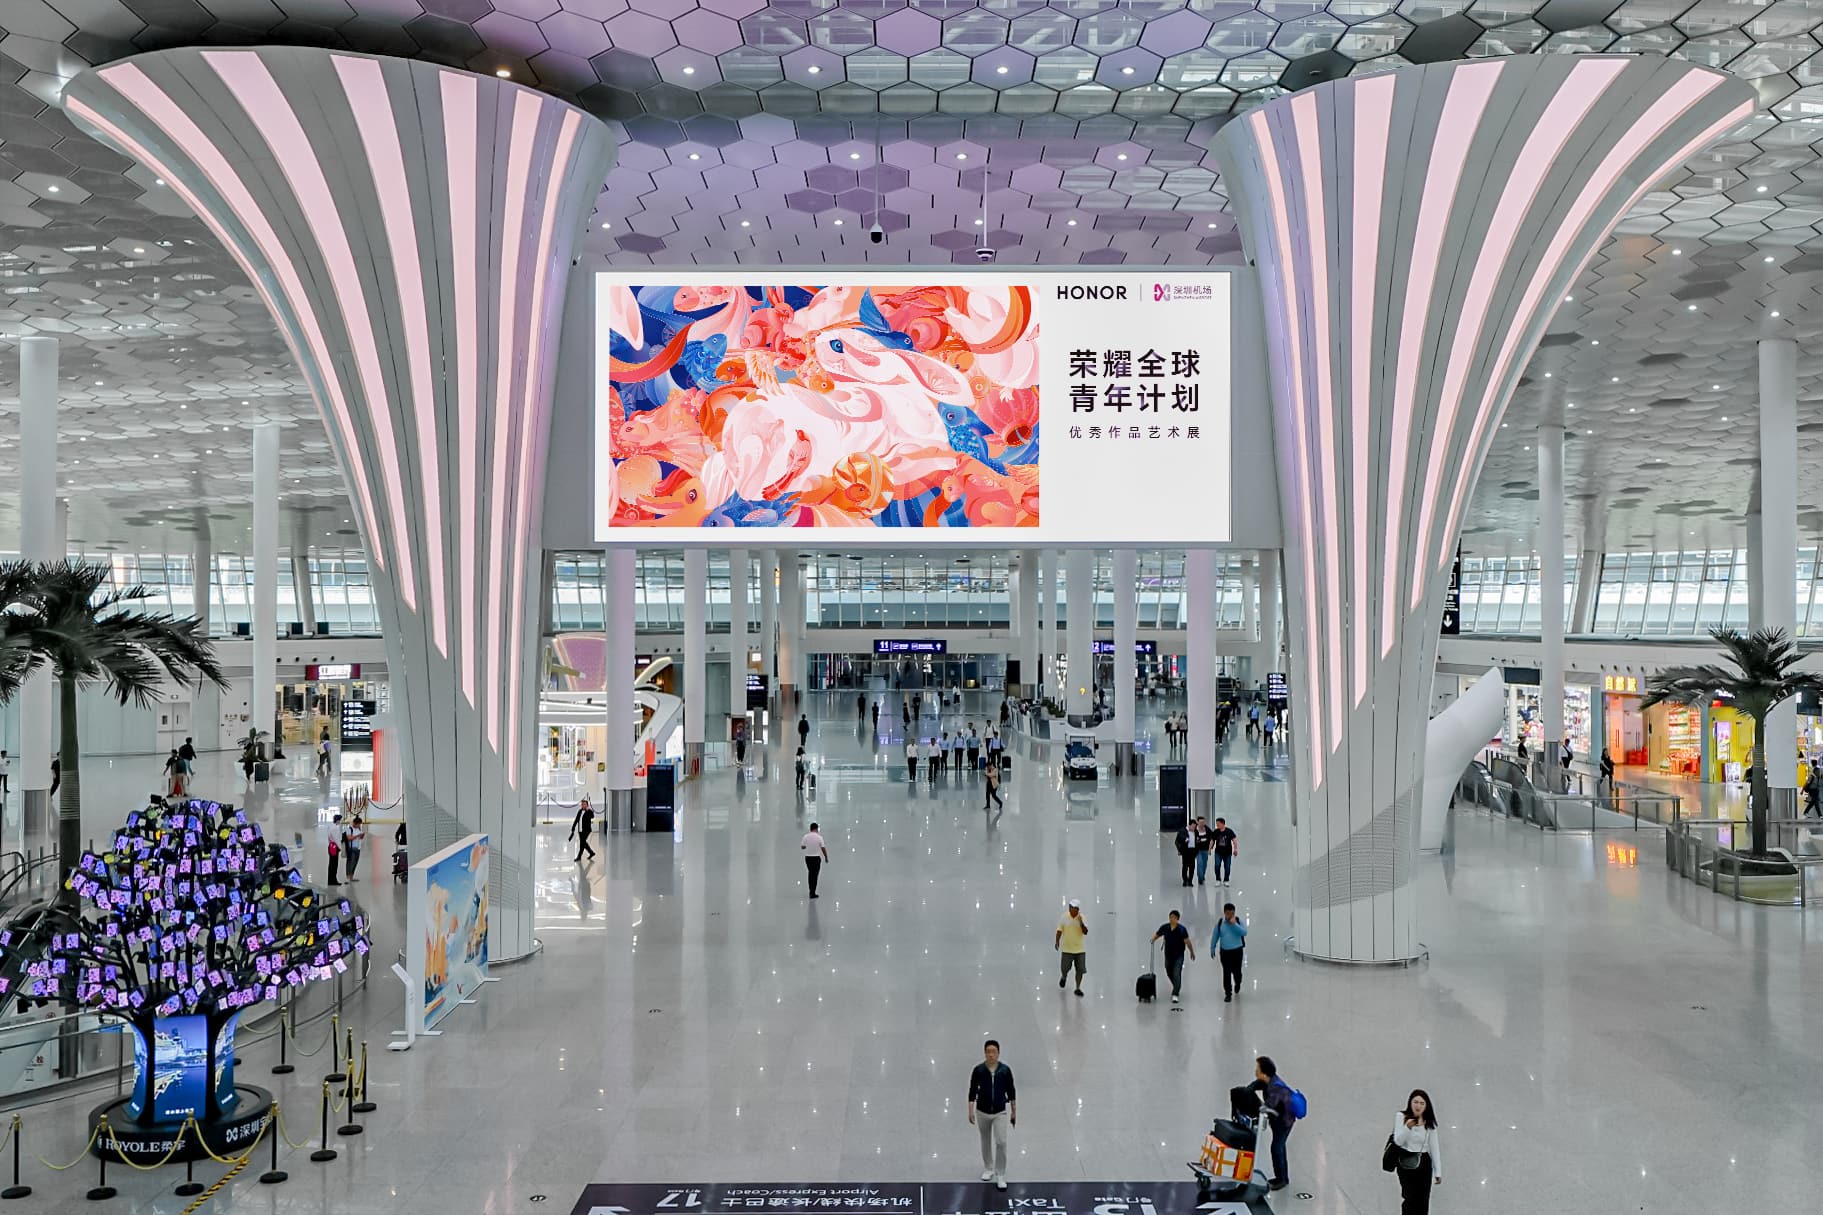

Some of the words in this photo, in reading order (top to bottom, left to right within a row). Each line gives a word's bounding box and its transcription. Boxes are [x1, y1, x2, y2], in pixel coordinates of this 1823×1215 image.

[1057, 285, 1128, 300] HONOR
[1173, 285, 1212, 295] 深圳机场
[1069, 349, 1200, 379] 荣耀全球
[1069, 384, 1199, 413] 青年计划
[1069, 425, 1200, 439] 优秀作品艺术展
[105, 1140, 160, 1153] ROYOLE
[727, 1188, 827, 1196] Express/Coach
[656, 1193, 702, 1207] 17
[720, 1197, 913, 1207] 机场快线/长途巴士
[1007, 1198, 1066, 1209] Taxi
